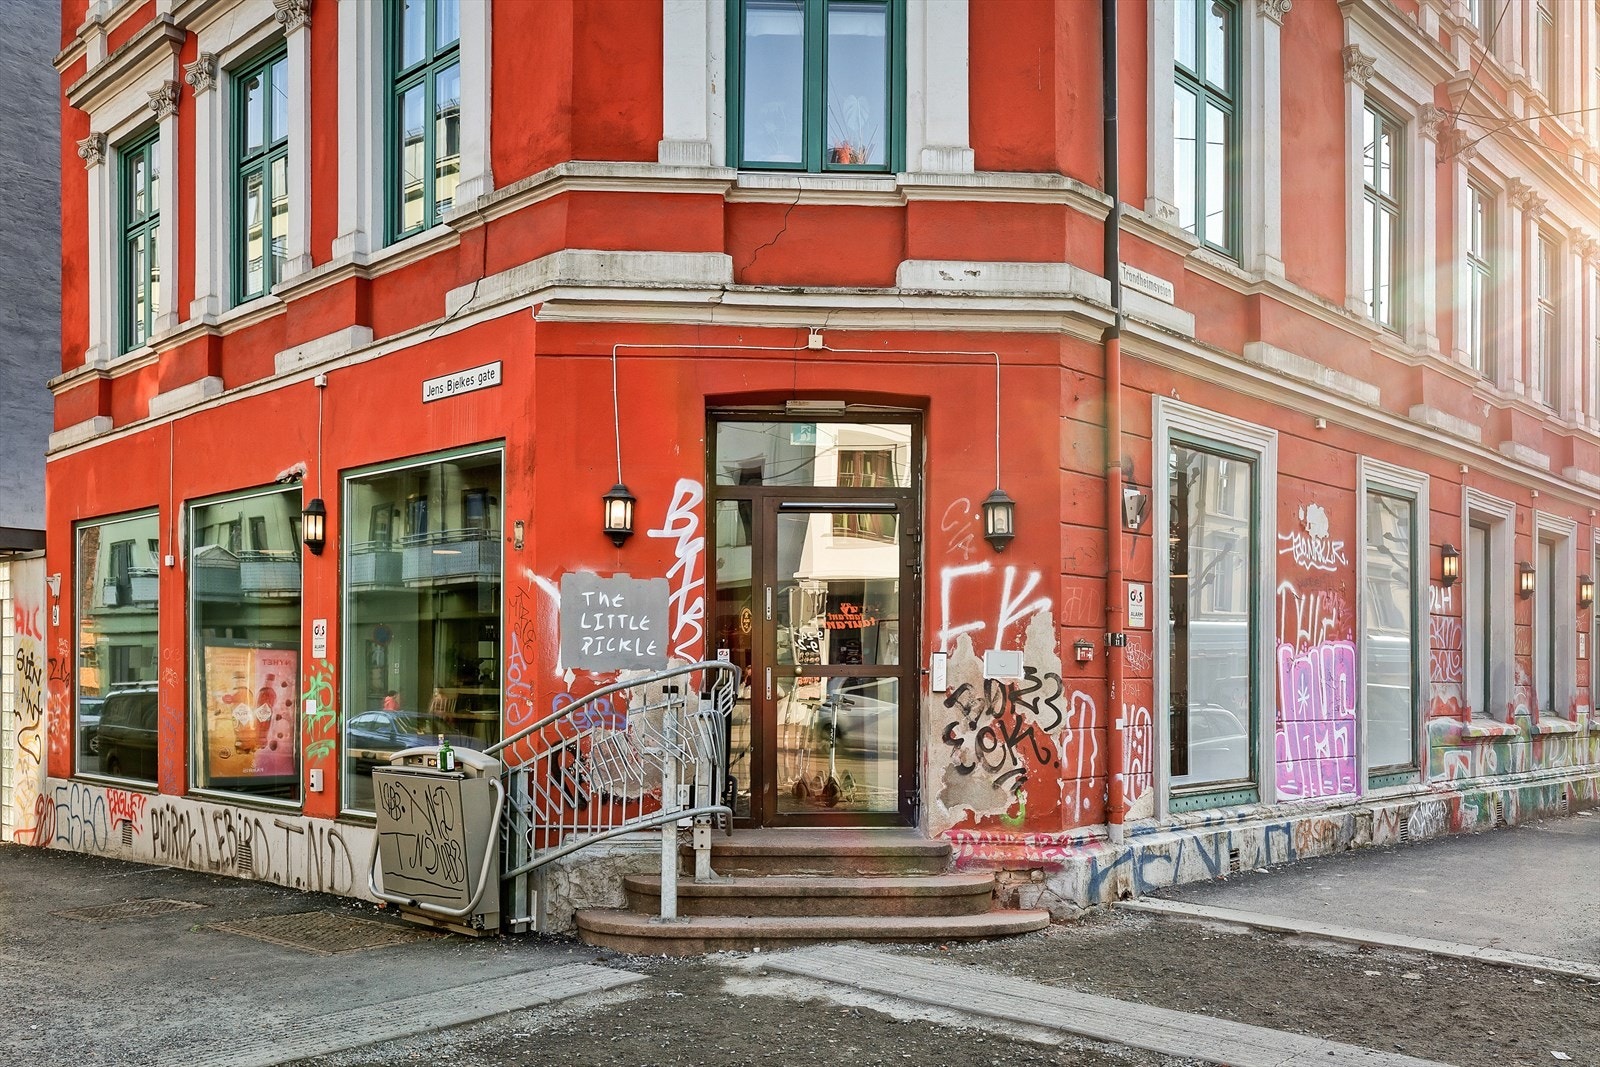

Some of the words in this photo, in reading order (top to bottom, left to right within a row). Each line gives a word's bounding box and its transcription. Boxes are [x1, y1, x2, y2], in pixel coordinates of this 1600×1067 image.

[1121, 265, 1172, 298] Trondheimsveien
[427, 384, 444, 397] Jens
[447, 376, 475, 393] Bjelkes
[478, 369, 496, 386] gate
[580, 612, 650, 632] LITTLE
[581, 636, 657, 656] PICKLE
